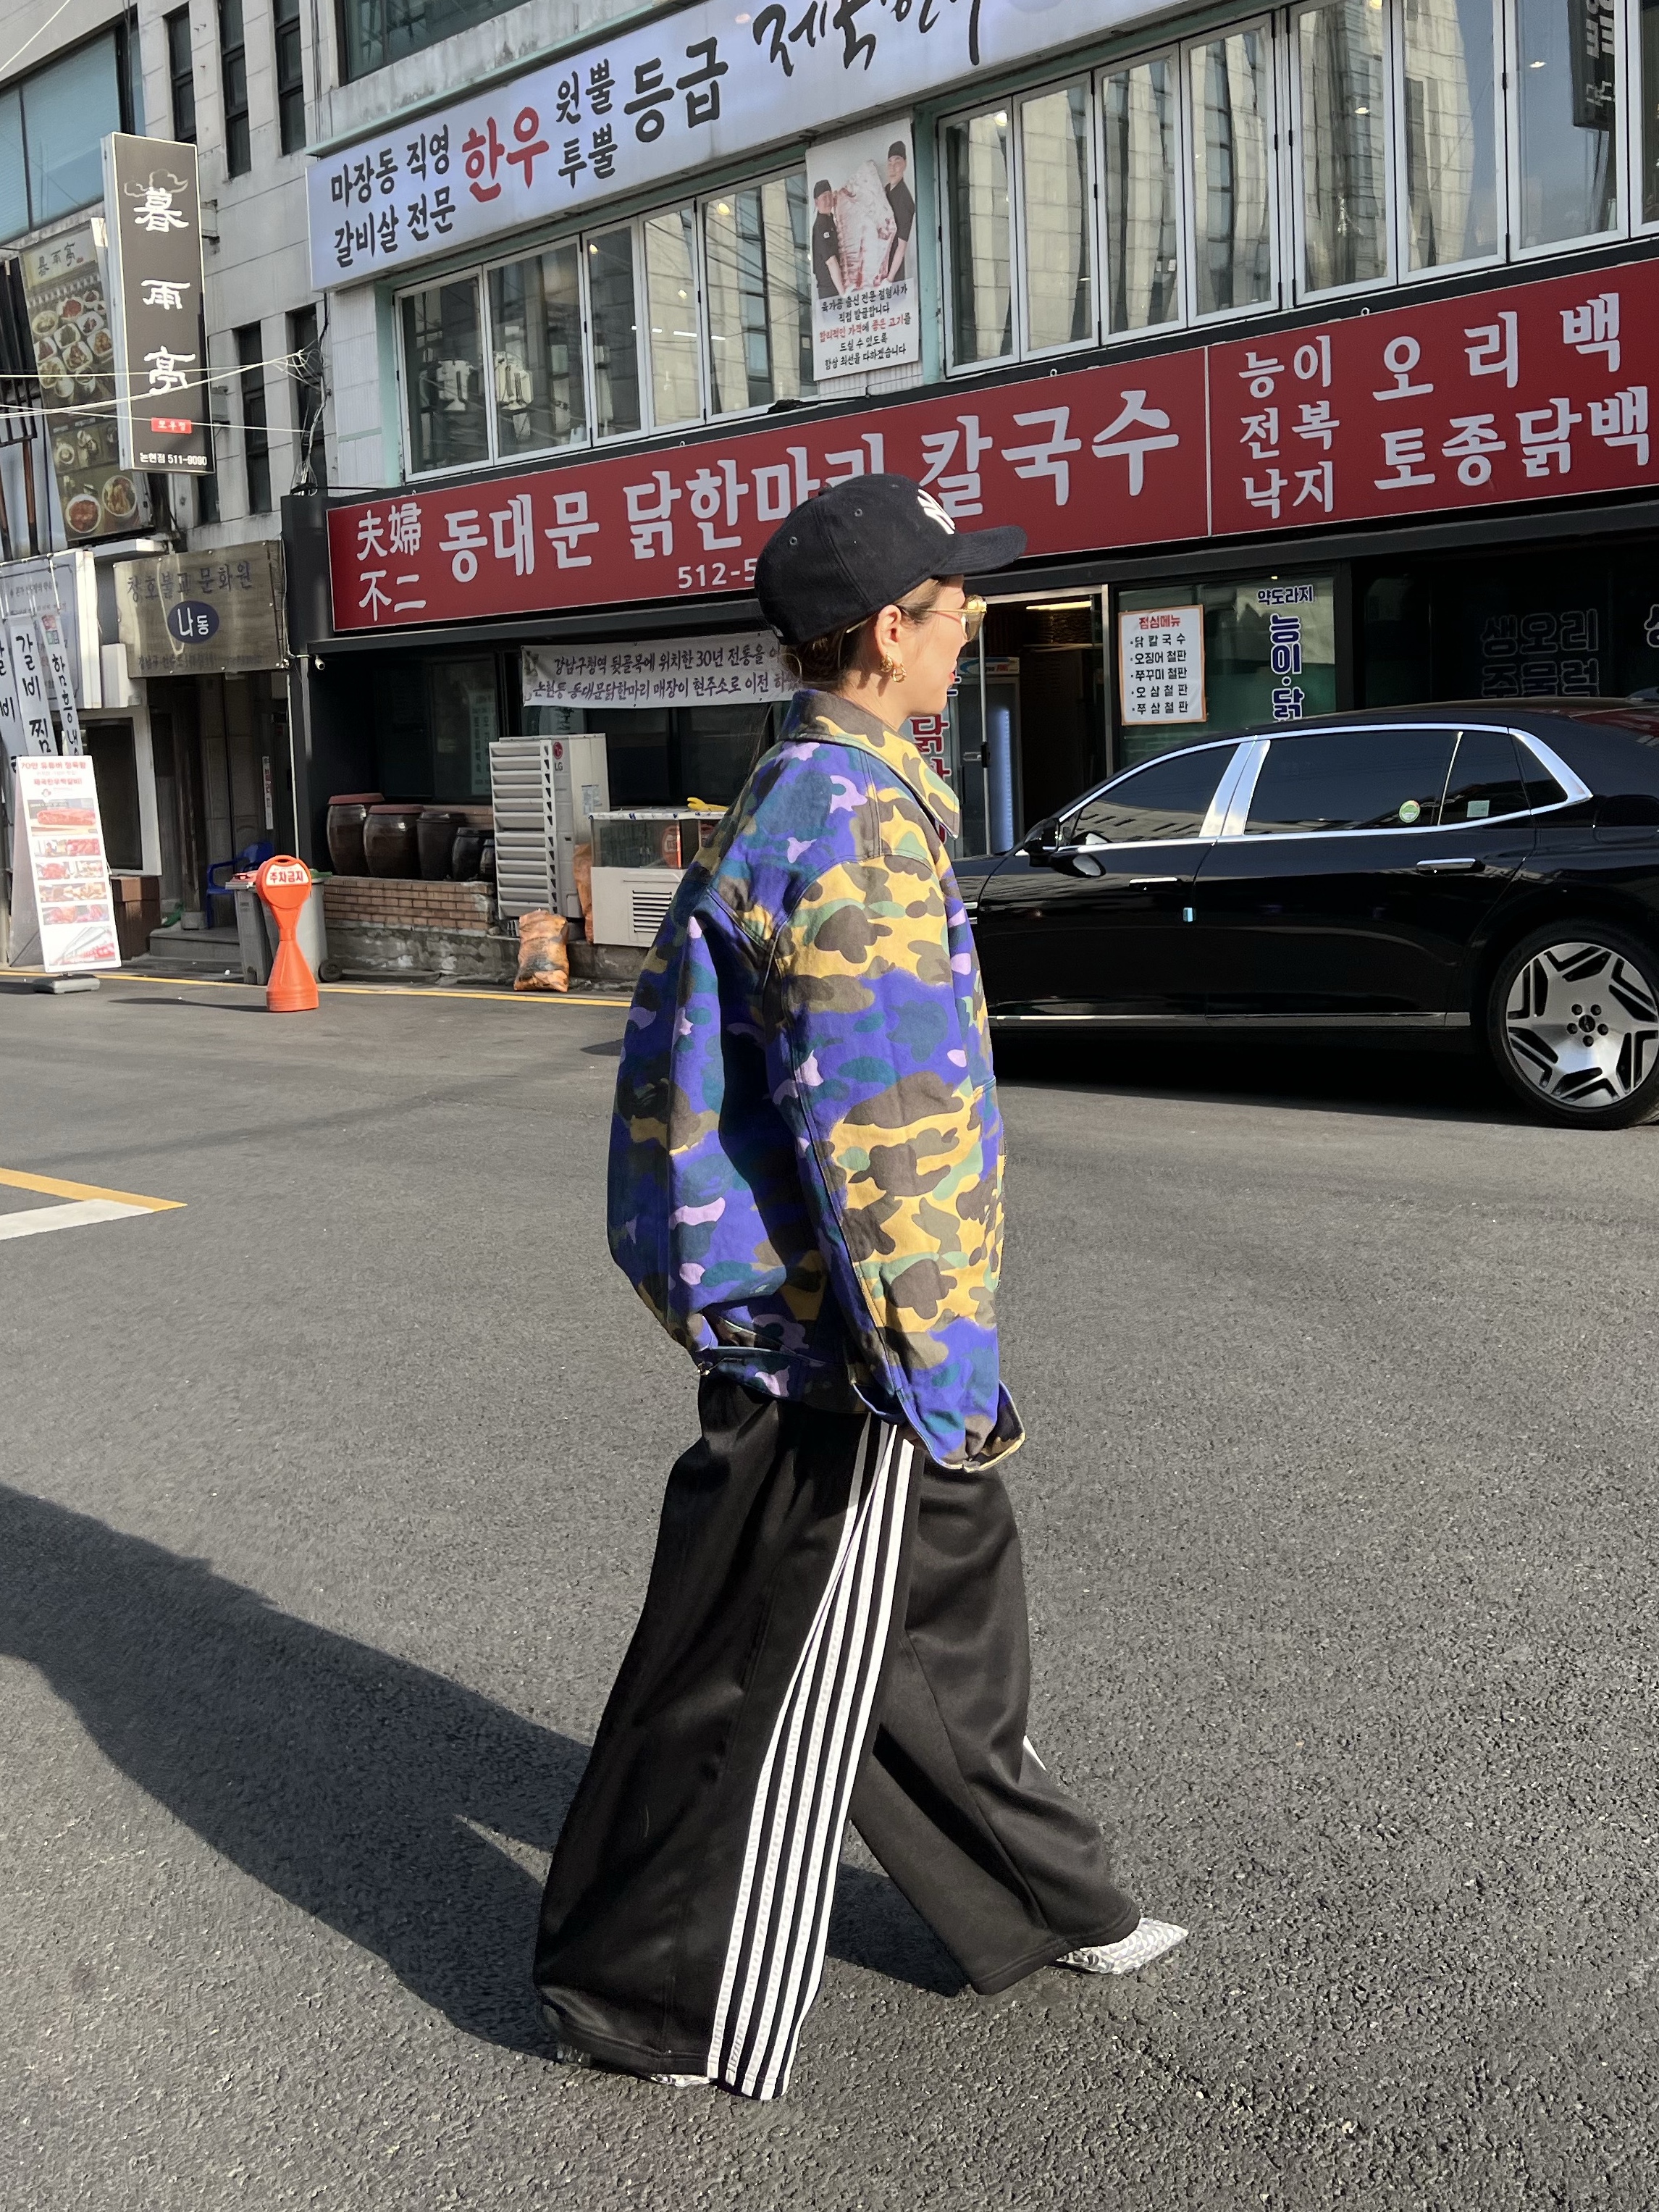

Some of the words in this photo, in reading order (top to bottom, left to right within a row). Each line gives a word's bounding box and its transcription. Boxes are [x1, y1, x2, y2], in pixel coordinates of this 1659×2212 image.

[623, 36, 728, 143] 등급
[330, 148, 399, 209] 마장동
[406, 124, 450, 183] 직영
[462, 106, 550, 203] 한우
[558, 122, 618, 189] 투뿔
[334, 204, 399, 269] 갈비살
[407, 185, 456, 242] 전문
[821, 298, 844, 313] 육가공
[845, 293, 860, 309] 출신
[861, 291, 877, 304] 전문
[838, 309, 852, 324] 직접
[819, 327, 846, 343] 합리적인
[847, 321, 870, 335] 가격에
[871, 318, 886, 332] 좋은
[888, 312, 912, 327] 고기를
[839, 338, 854, 352] 드실
[855, 338, 864, 349] 수
[865, 332, 888, 348] 있도록
[825, 356, 839, 371] 항상
[840, 352, 860, 366] 최선을
[862, 343, 907, 361] 다하겠습니다
[1239, 335, 1331, 398] 능이
[1240, 400, 1340, 459] 전복
[1374, 385, 1649, 490] 토종닭백
[438, 488, 600, 583] 동대문
[622, 432, 886, 561] 닭한마리
[917, 389, 1180, 519] 칼국수
[1242, 459, 1334, 519] 낙지
[356, 501, 422, 561] 夫婦
[358, 569, 427, 623] 不二
[1257, 584, 1314, 606] 약도라지
[177, 607, 210, 637] 나동
[1138, 614, 1181, 630] 점심메뉴
[1479, 607, 1600, 659] 생오리
[554, 654, 608, 675] 강남구청역
[610, 652, 655, 675] 뒷골목에
[658, 649, 694, 672] 위치한
[696, 647, 723, 668] 30년
[727, 644, 765, 668] 전통을
[1134, 651, 1164, 665] 오징어
[1167, 650, 1187, 663] 철판
[653, 677, 689, 699] 매장이
[692, 676, 742, 697] 현주소로
[744, 671, 769, 694] 이전
[1135, 668, 1165, 682] 쭈꾸미
[1167, 666, 1188, 680] 철판
[554, 762, 563, 771] LG
[269, 871, 303, 884] 주차금지
